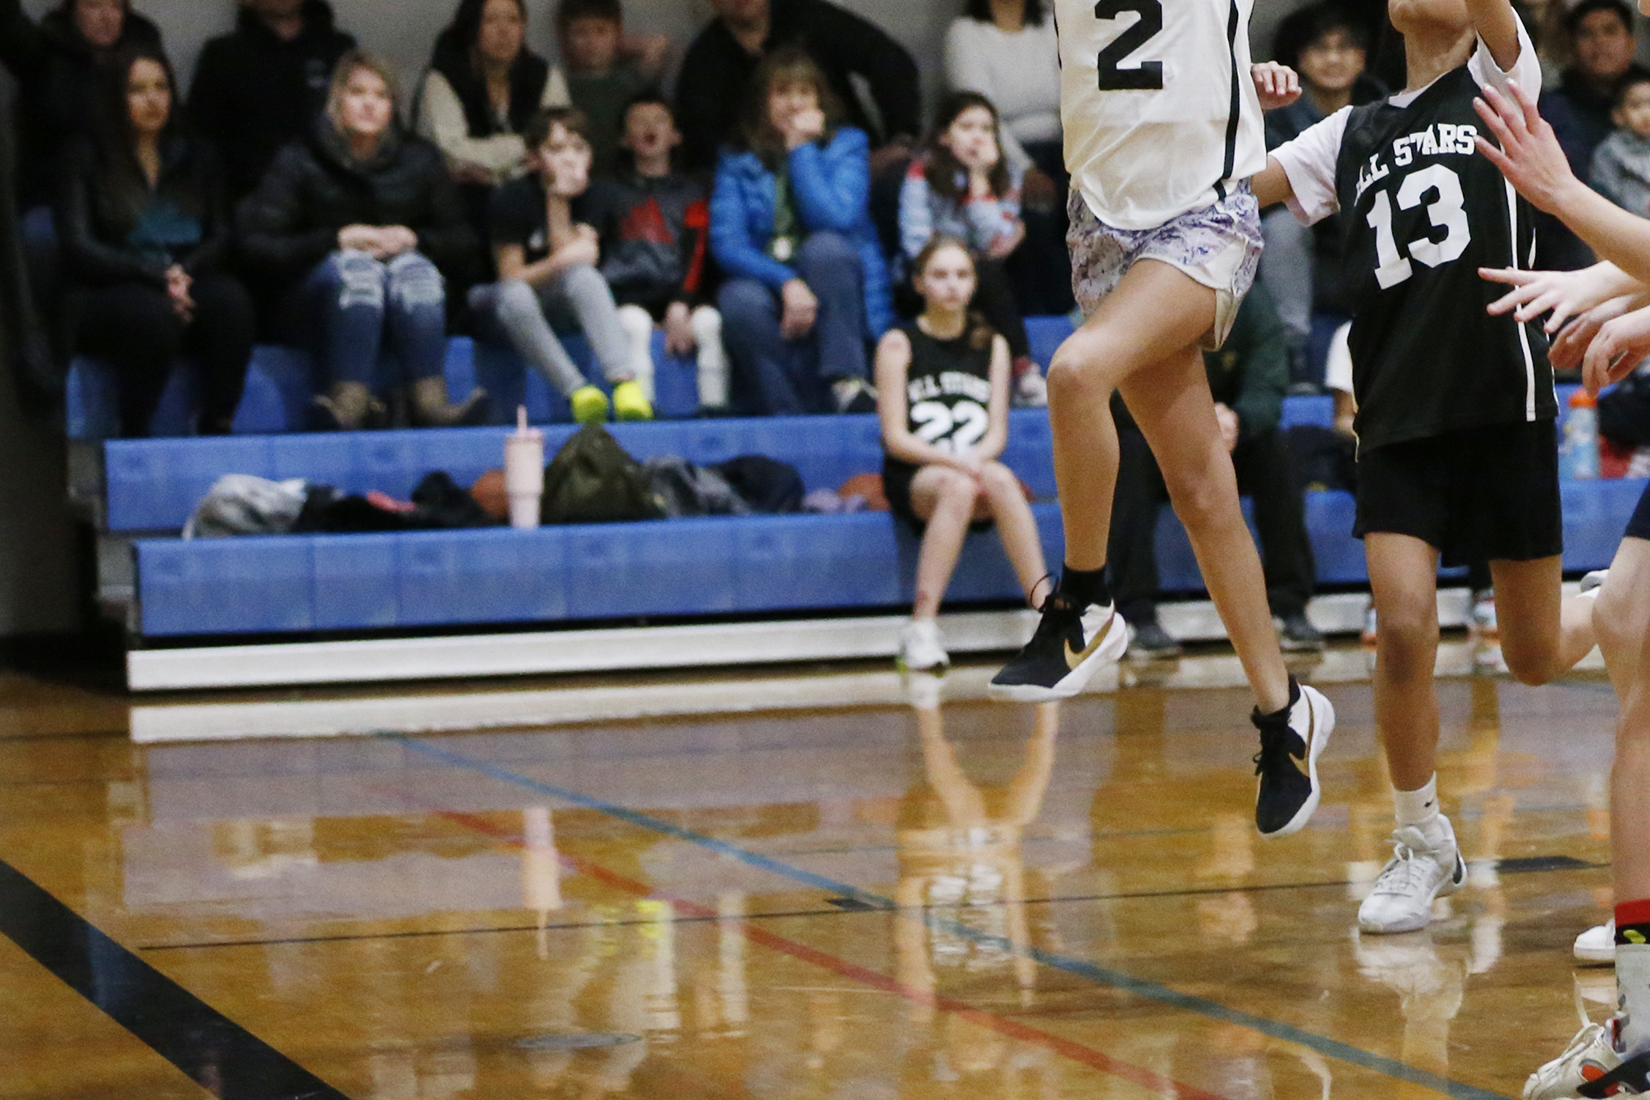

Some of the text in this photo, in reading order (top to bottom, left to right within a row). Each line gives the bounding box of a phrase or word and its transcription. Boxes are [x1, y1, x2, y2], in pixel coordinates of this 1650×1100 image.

[1393, 123, 1478, 167] STARS
[1366, 163, 1471, 290] 13
[910, 400, 989, 457] 22
